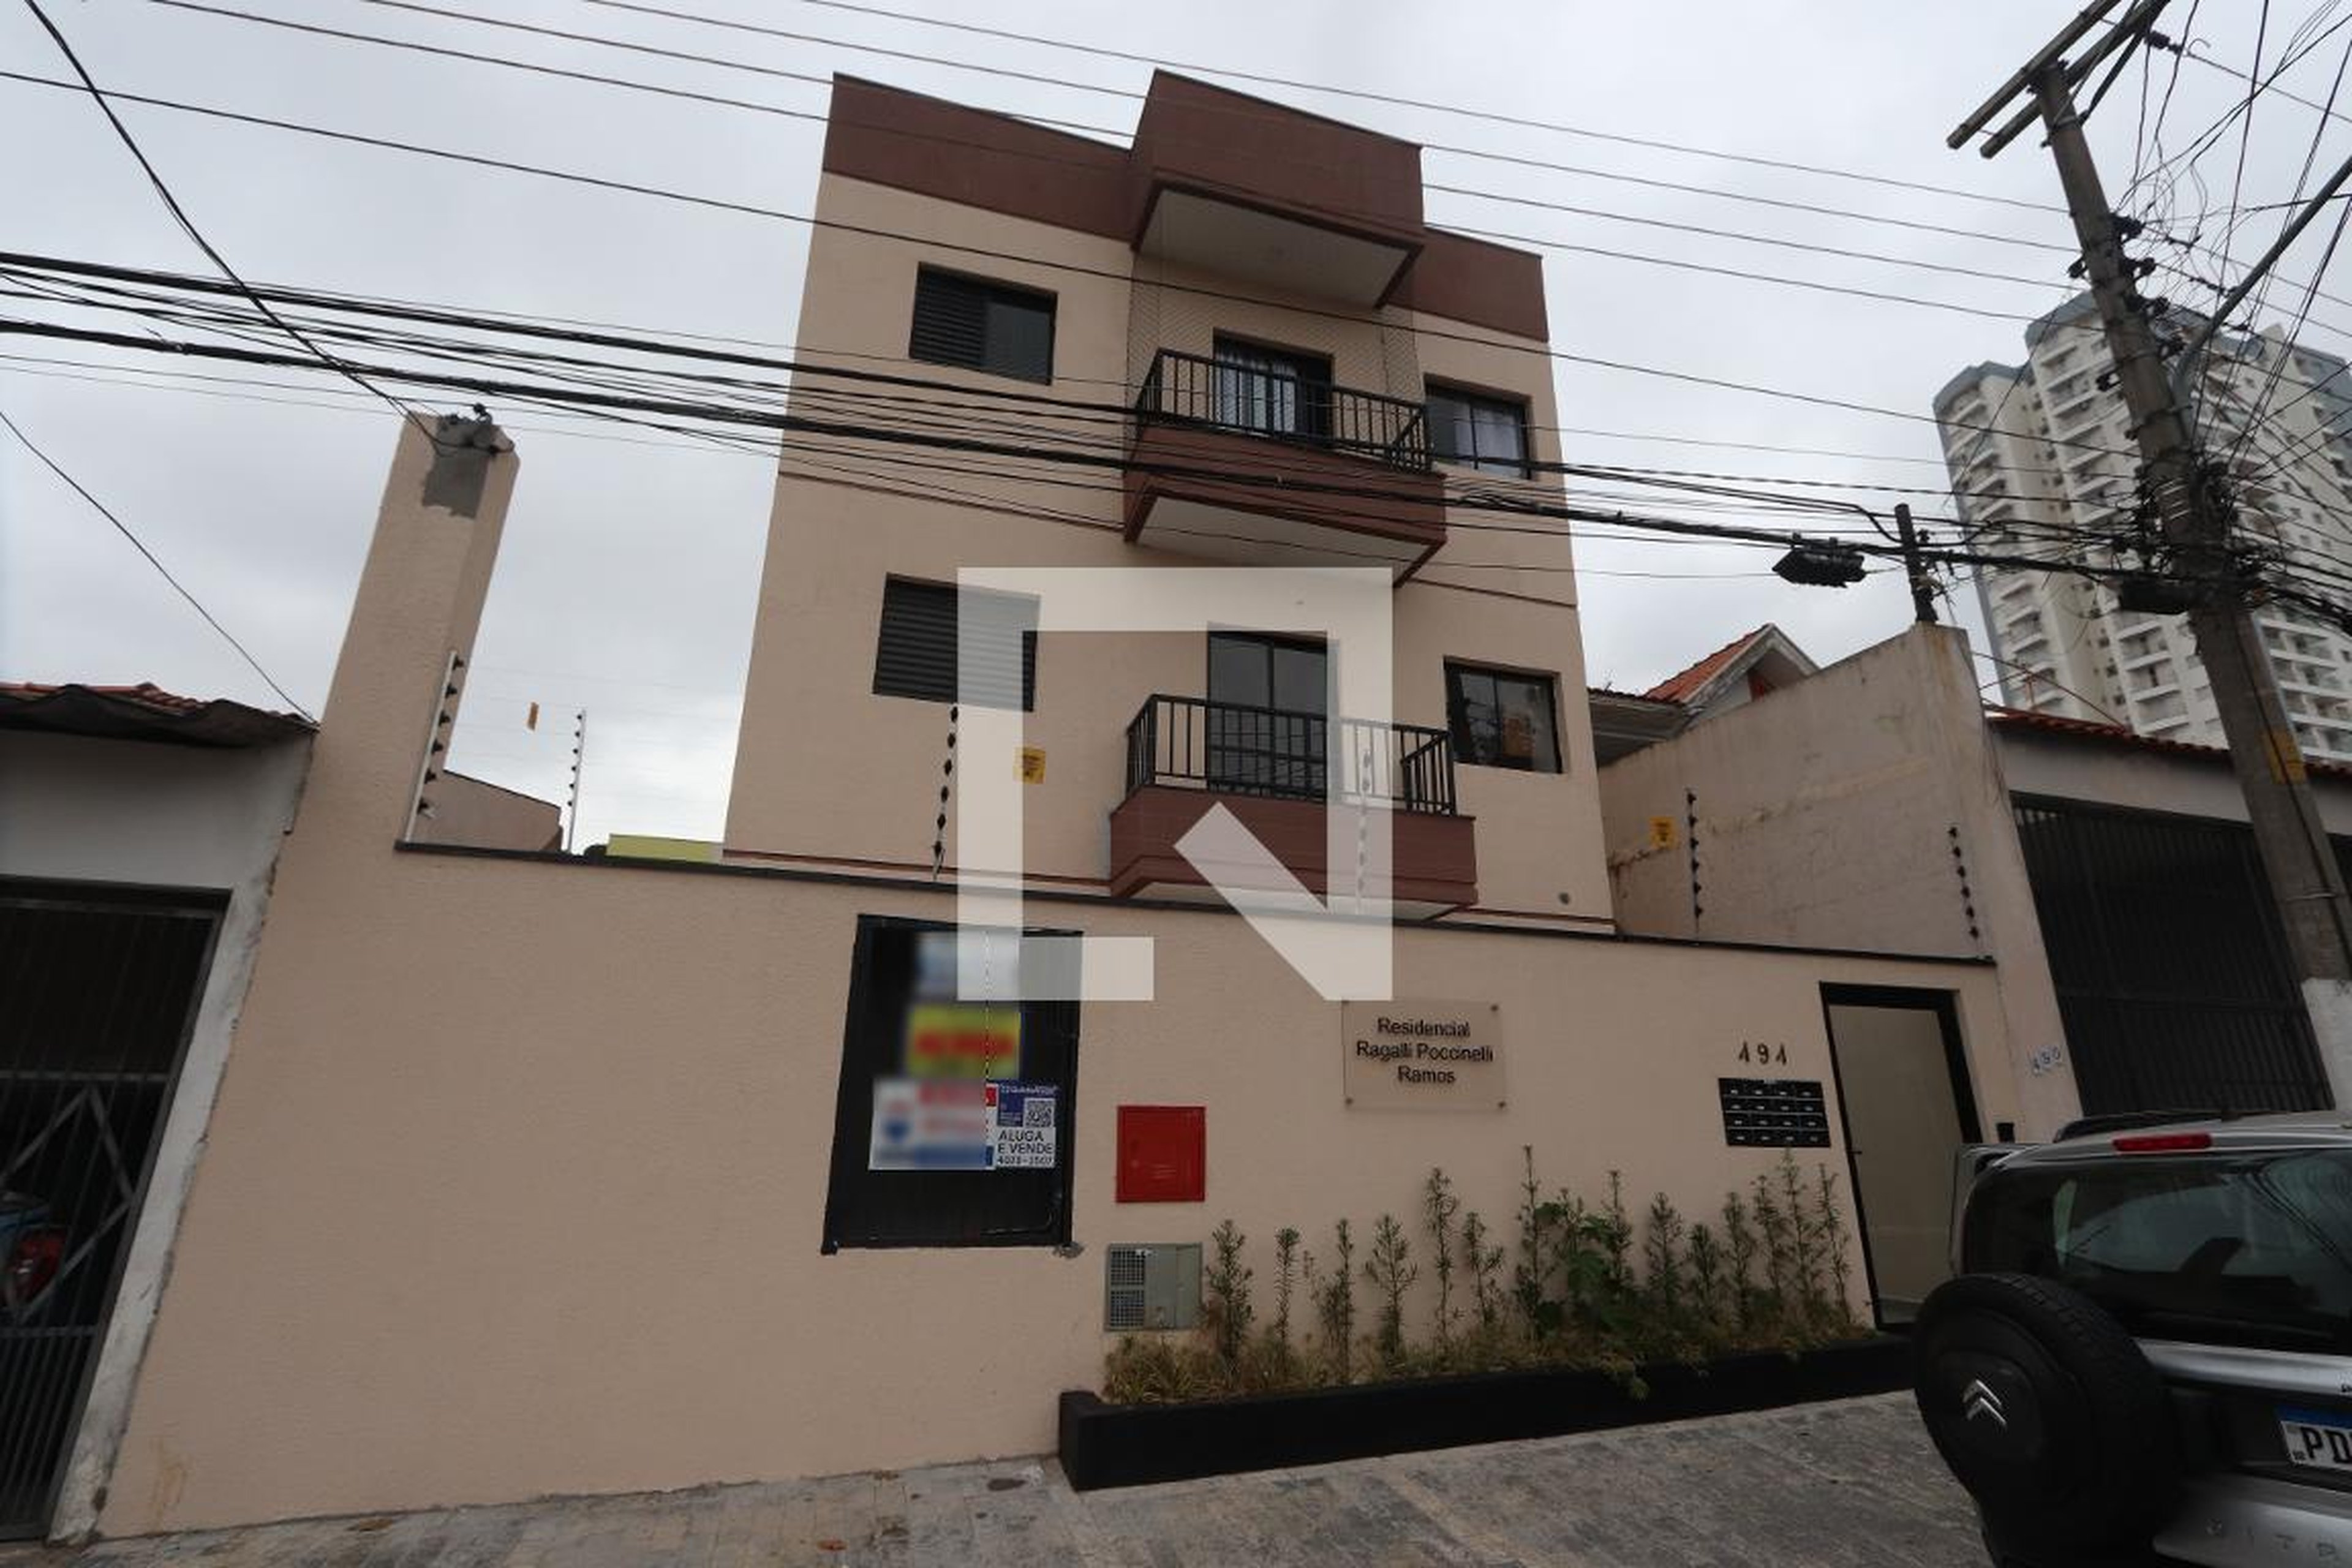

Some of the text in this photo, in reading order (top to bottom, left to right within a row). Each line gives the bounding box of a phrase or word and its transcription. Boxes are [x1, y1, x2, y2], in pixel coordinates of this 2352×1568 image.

[1378, 1017, 1470, 1037] Residencial
[1397, 1065, 1456, 1083] Ramos
[998, 1130, 1044, 1142] ALUGA
[998, 1143, 1054, 1154] E VENDE
[2301, 1427, 2352, 1464] PD
